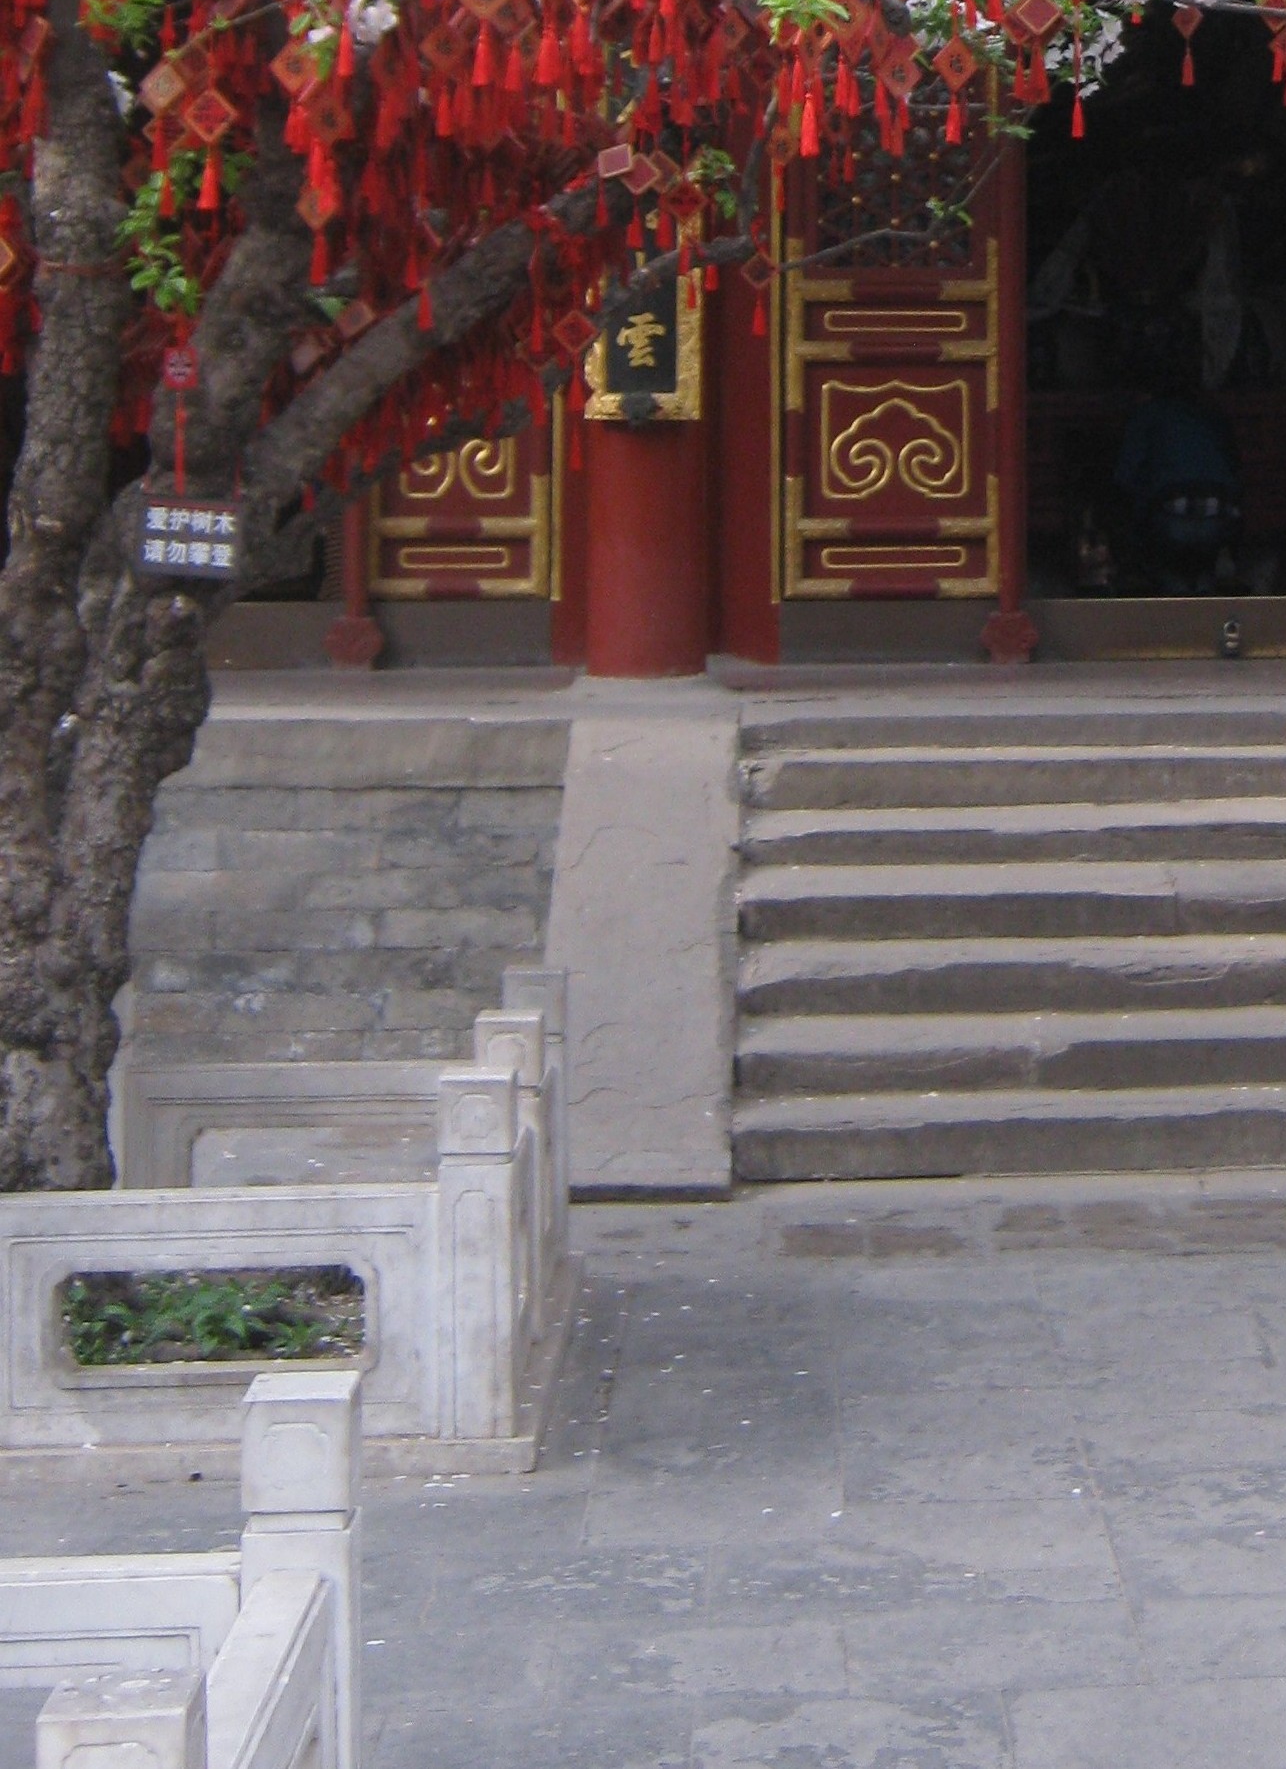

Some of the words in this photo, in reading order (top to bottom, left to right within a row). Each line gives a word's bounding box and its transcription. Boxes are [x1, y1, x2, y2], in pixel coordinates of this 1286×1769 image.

[617, 312, 666, 367] 雲
[146, 506, 236, 535] 爱护树木
